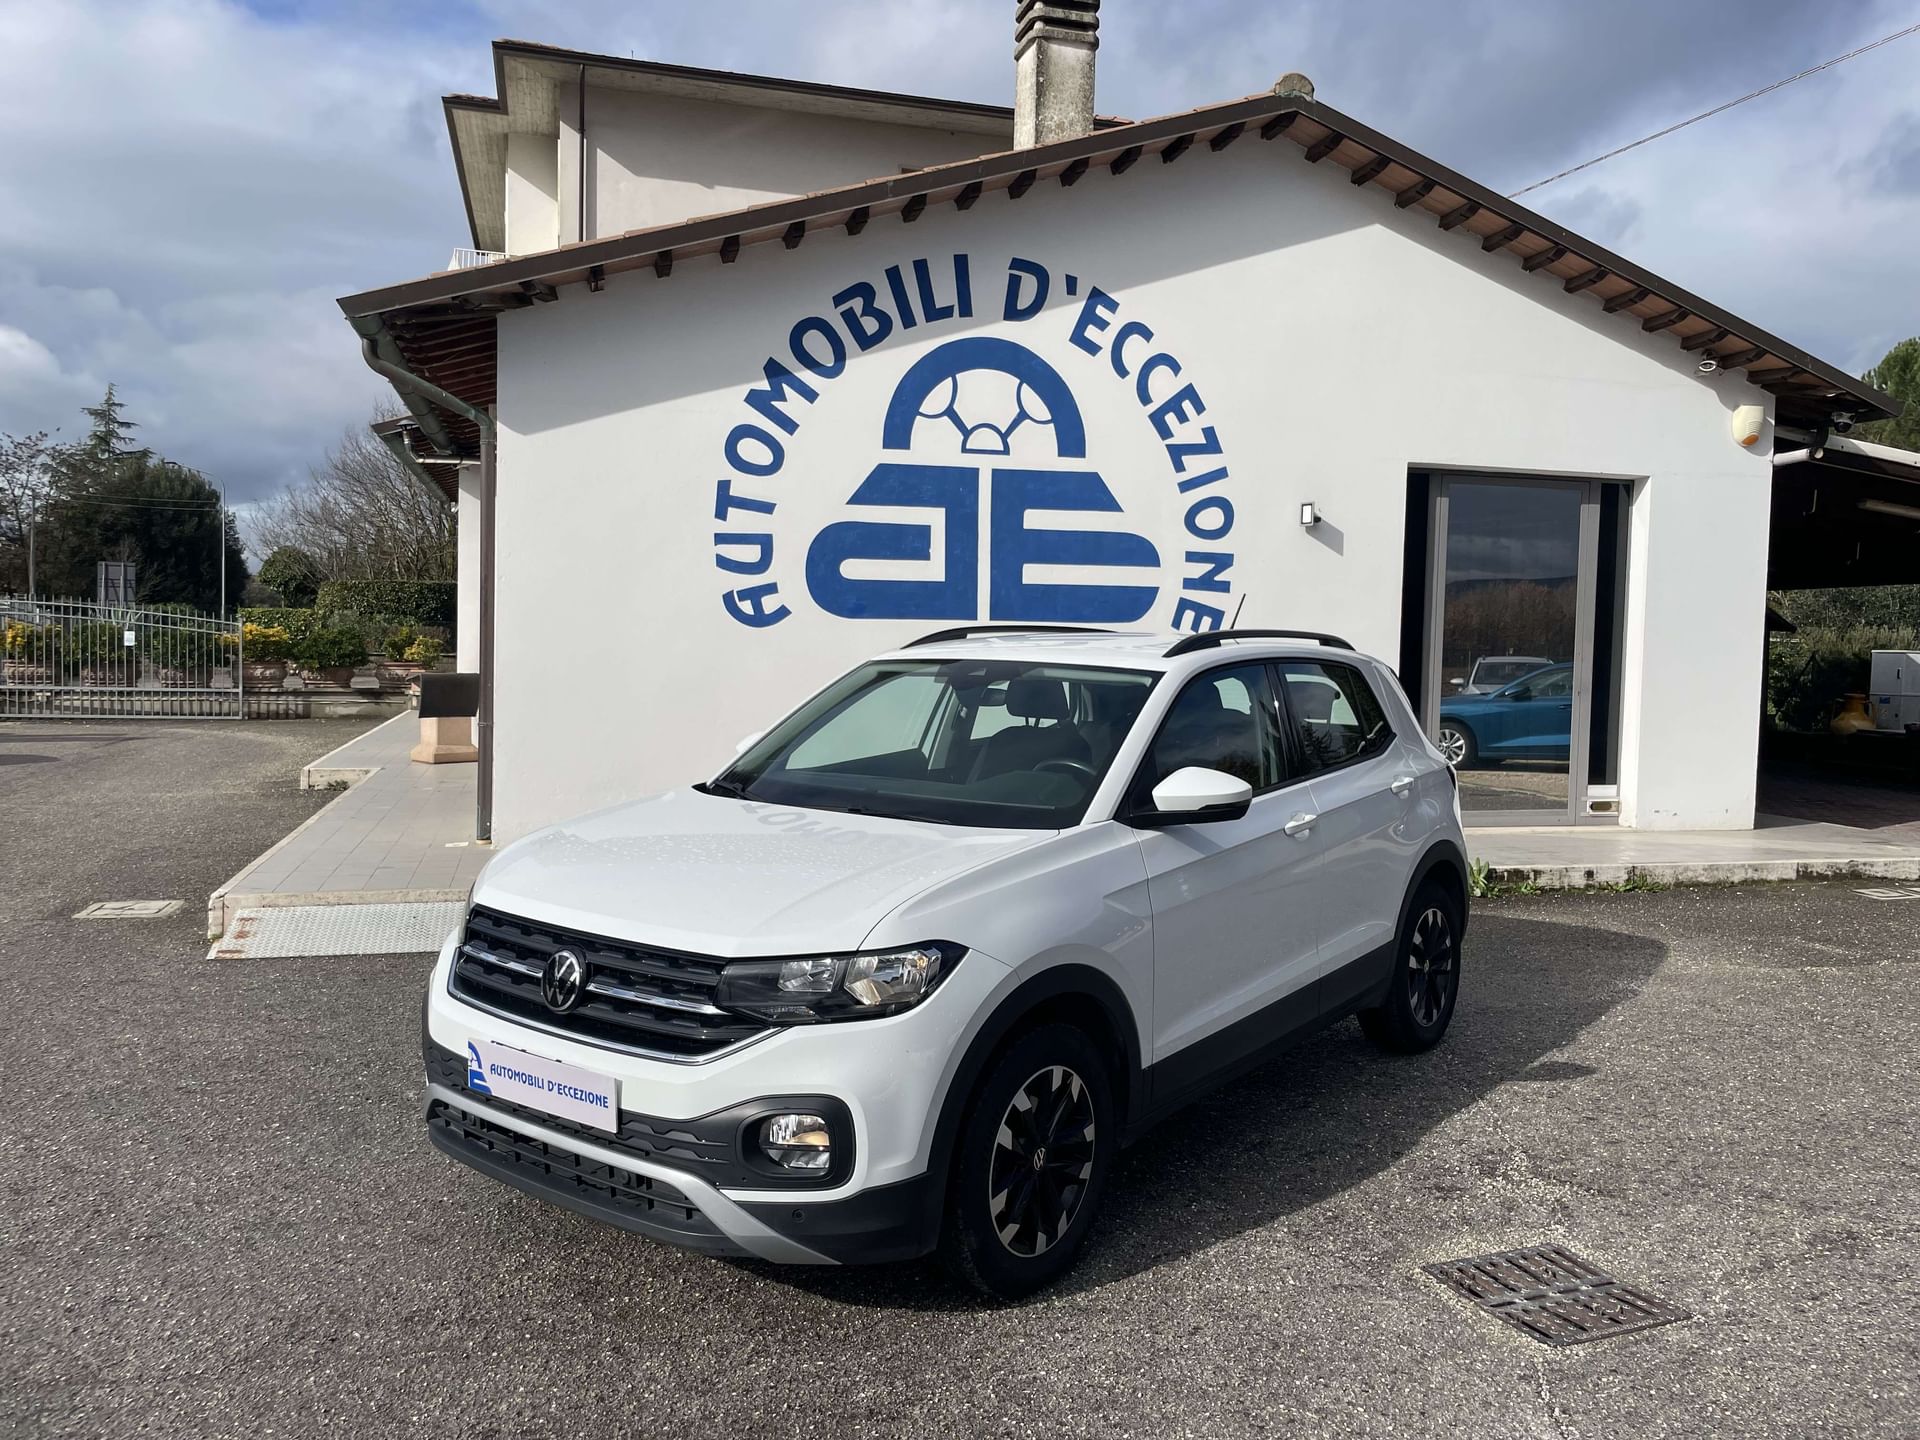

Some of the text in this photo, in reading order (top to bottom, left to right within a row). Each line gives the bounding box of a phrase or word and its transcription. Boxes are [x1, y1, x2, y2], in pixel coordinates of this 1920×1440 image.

[714, 254, 1234, 632] AUTOMOBILI D'ECCEZIONE
[490, 1063, 609, 1109] AUTOMOBILI D'ECCEZIONE
